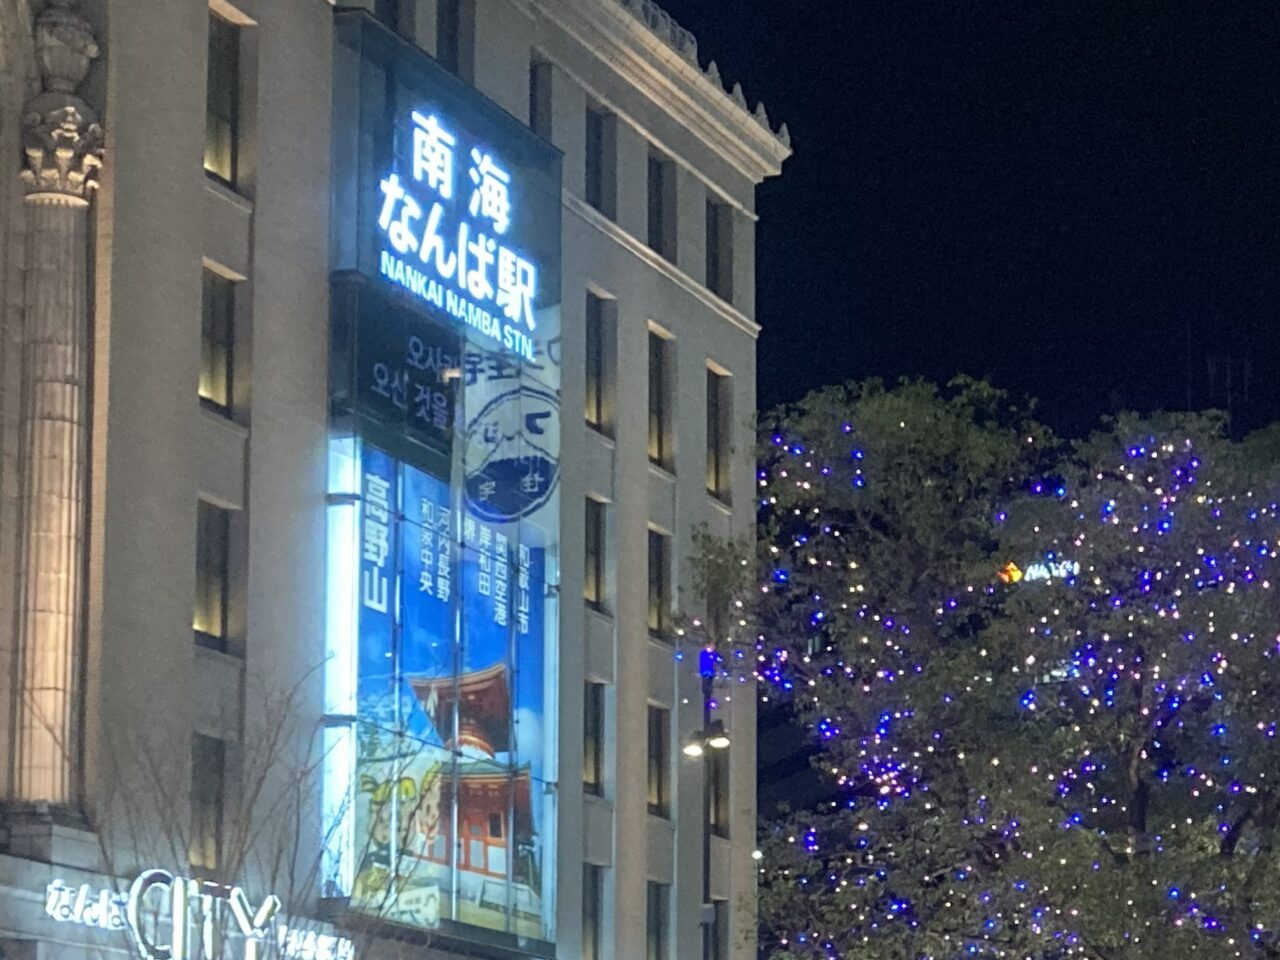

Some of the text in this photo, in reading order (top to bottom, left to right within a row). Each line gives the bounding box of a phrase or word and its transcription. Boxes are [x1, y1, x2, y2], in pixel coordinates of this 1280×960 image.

[411, 110, 511, 235] 南海
[379, 174, 537, 331] なんば駅
[381, 251, 536, 362] NANKAI NAMBA STN.
[362, 472, 391, 614] 高野山
